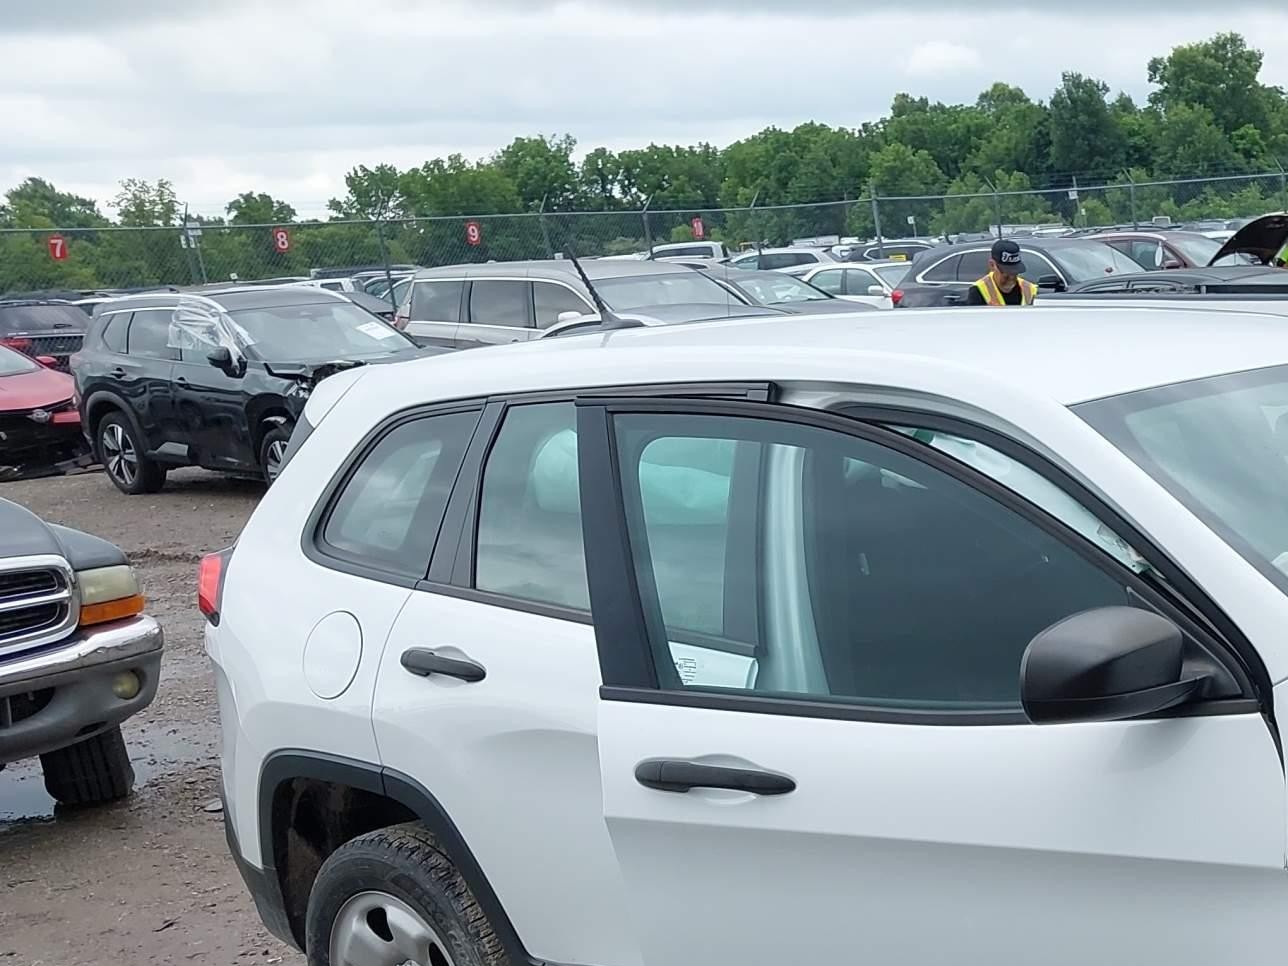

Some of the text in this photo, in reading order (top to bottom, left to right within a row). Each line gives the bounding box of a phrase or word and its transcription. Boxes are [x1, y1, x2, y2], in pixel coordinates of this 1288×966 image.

[277, 231, 289, 249] 8
[468, 225, 479, 241] 9
[50, 239, 62, 257] 7
